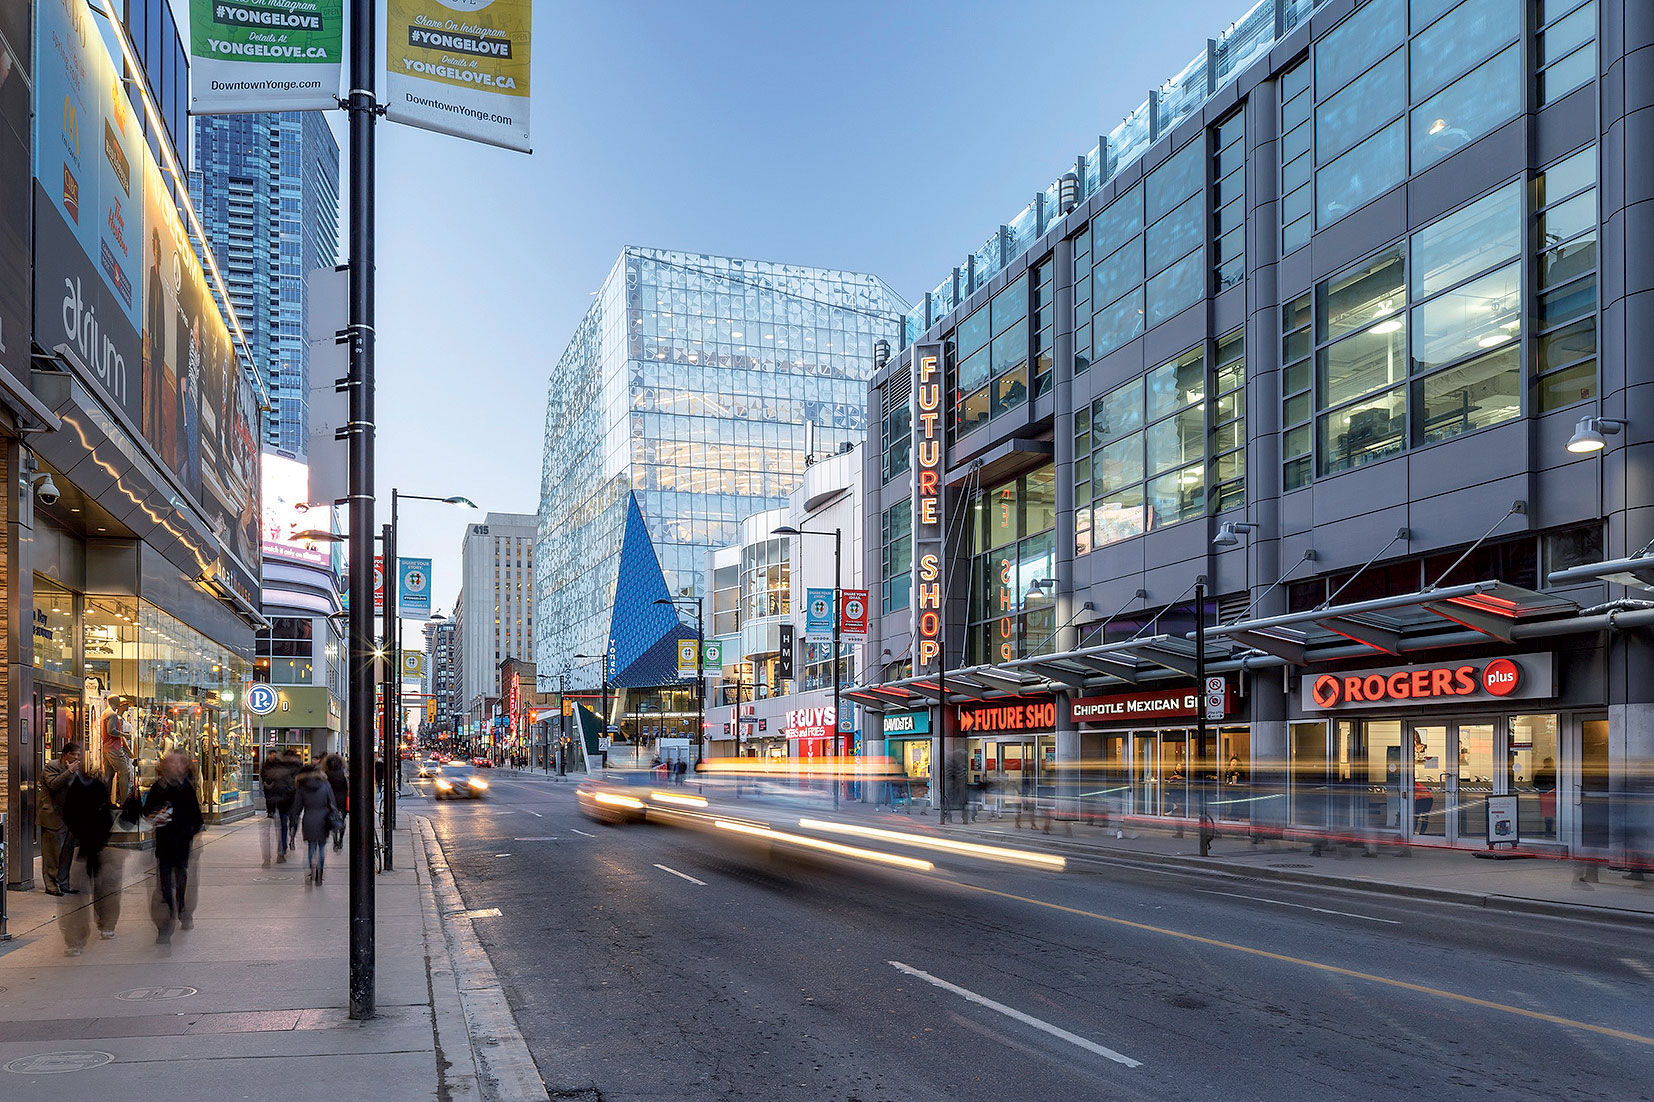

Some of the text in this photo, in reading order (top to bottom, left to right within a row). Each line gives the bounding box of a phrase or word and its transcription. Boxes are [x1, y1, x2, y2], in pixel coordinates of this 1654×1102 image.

[216, 5, 319, 28] #YONGELOVE
[414, 15, 506, 39] Share On Instagram
[207, 38, 327, 58] YONGELOVE.CA
[249, 32, 287, 43] Details At
[411, 30, 508, 56] #YONGELOVE
[403, 58, 516, 89] YONGELOVE.CA
[441, 55, 478, 69] Details At
[211, 80, 321, 91] DowntownYonge.com
[405, 92, 512, 126] DowntownYonge.com
[64, 169, 78, 202] CIBC
[62, 276, 127, 406] atrium
[918, 356, 940, 525] FUTURE
[473, 525, 489, 535] 415
[918, 553, 941, 667] SHOP
[782, 634, 791, 671] HMV
[1344, 665, 1514, 702] ROGERS plus
[797, 706, 836, 727] GUYS
[974, 705, 1024, 731] FUTURE
[1073, 702, 1124, 716] CHIPOTLE
[1127, 698, 1179, 712] MEXICAN
[807, 726, 825, 737] FRIES
